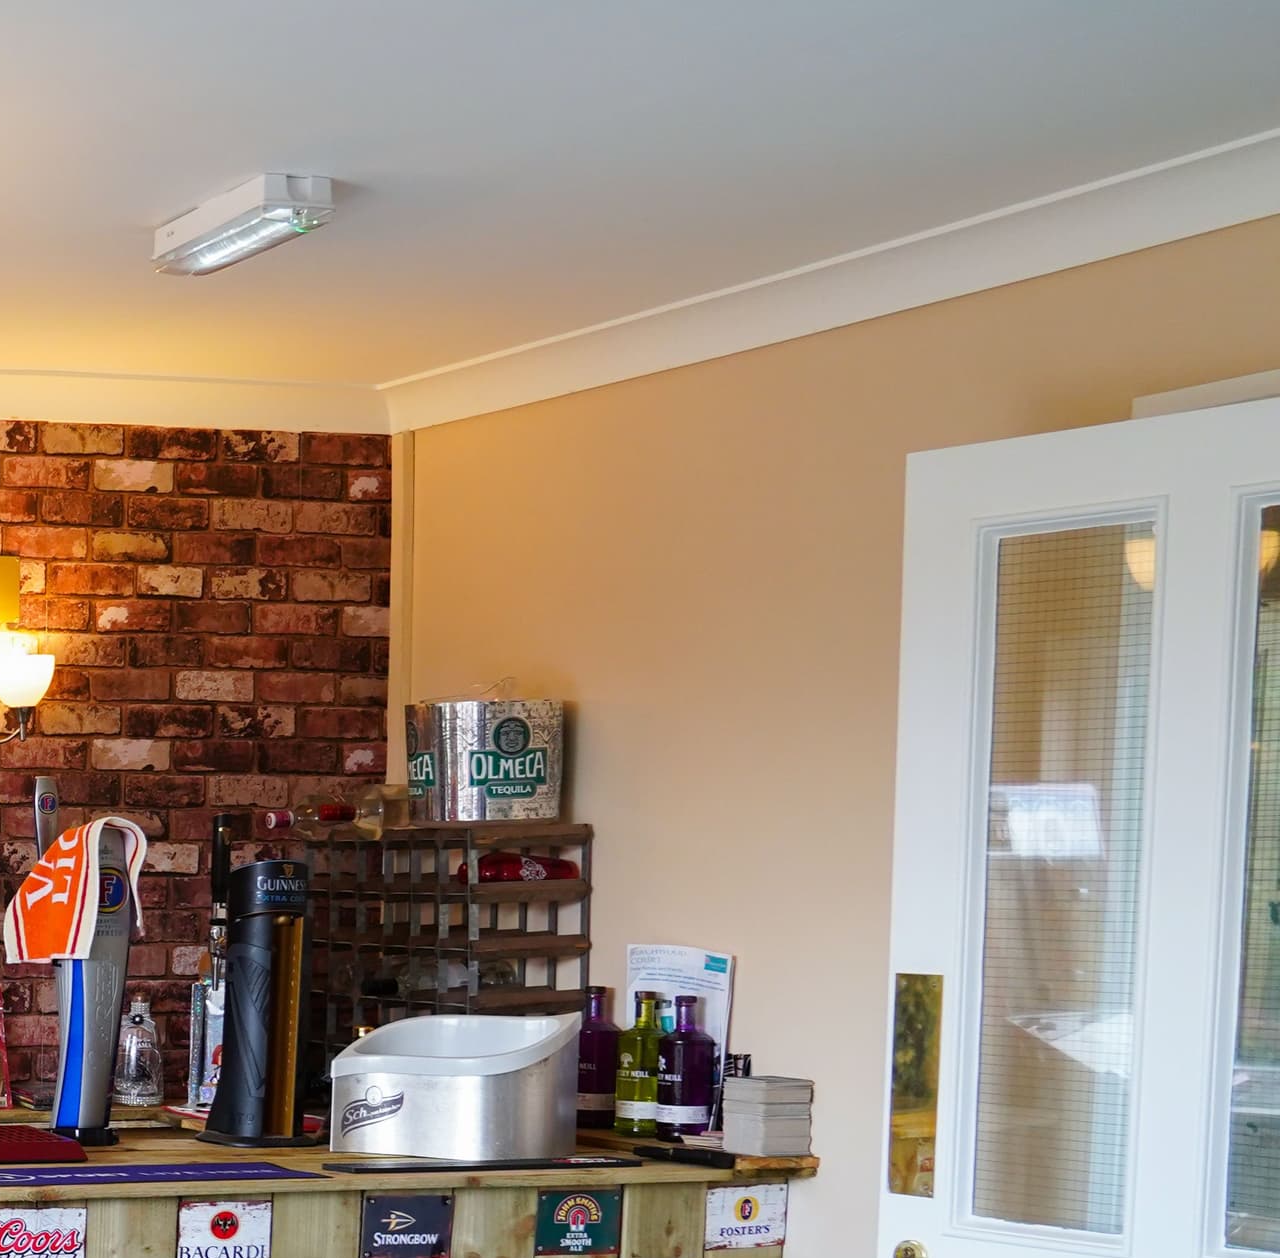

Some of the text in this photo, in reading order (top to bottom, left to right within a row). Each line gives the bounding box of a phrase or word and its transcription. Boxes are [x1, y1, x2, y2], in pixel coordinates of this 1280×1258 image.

[471, 752, 544, 780] OLMECA
[490, 785, 532, 795] TEQUILA
[557, 1199, 575, 1221] JOHN
[720, 1224, 772, 1237] FOSTER'S
[373, 1232, 439, 1247] STRONGBOW
[560, 1238, 592, 1247] SMOOTH
